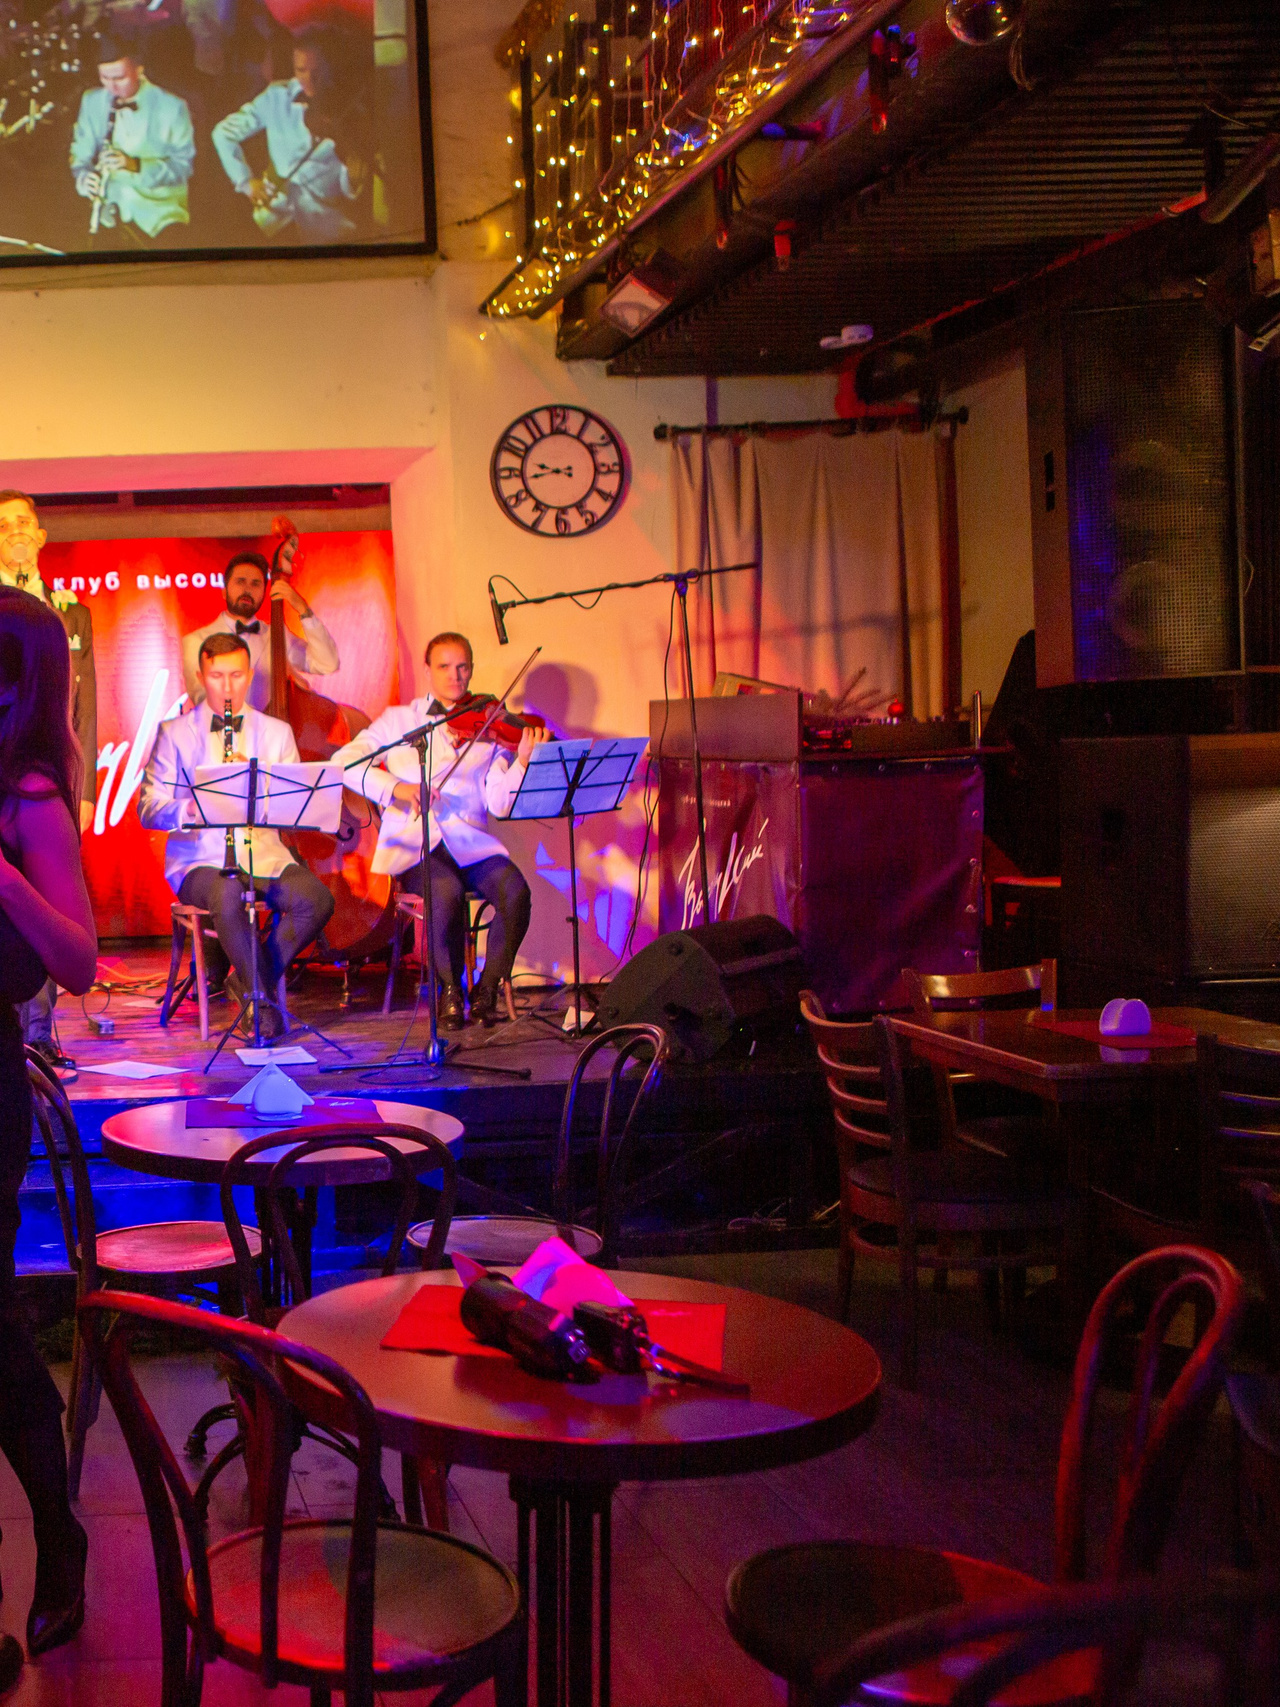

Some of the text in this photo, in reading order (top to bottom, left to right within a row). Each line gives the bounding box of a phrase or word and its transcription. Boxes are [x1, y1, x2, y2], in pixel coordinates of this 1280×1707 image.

[522, 414, 544, 440] 11
[548, 408, 568, 434] 12
[577, 413, 590, 438] 1
[502, 435, 528, 458] 10
[587, 434, 612, 454] 2
[497, 466, 521, 480] 9
[597, 461, 620, 475] 3
[505, 488, 531, 508] 8
[594, 487, 617, 502] 4
[531, 501, 549, 529] 7
[555, 507, 570, 535] 6
[576, 501, 599, 527] 5
[53, 569, 271, 595] клуб высоц
